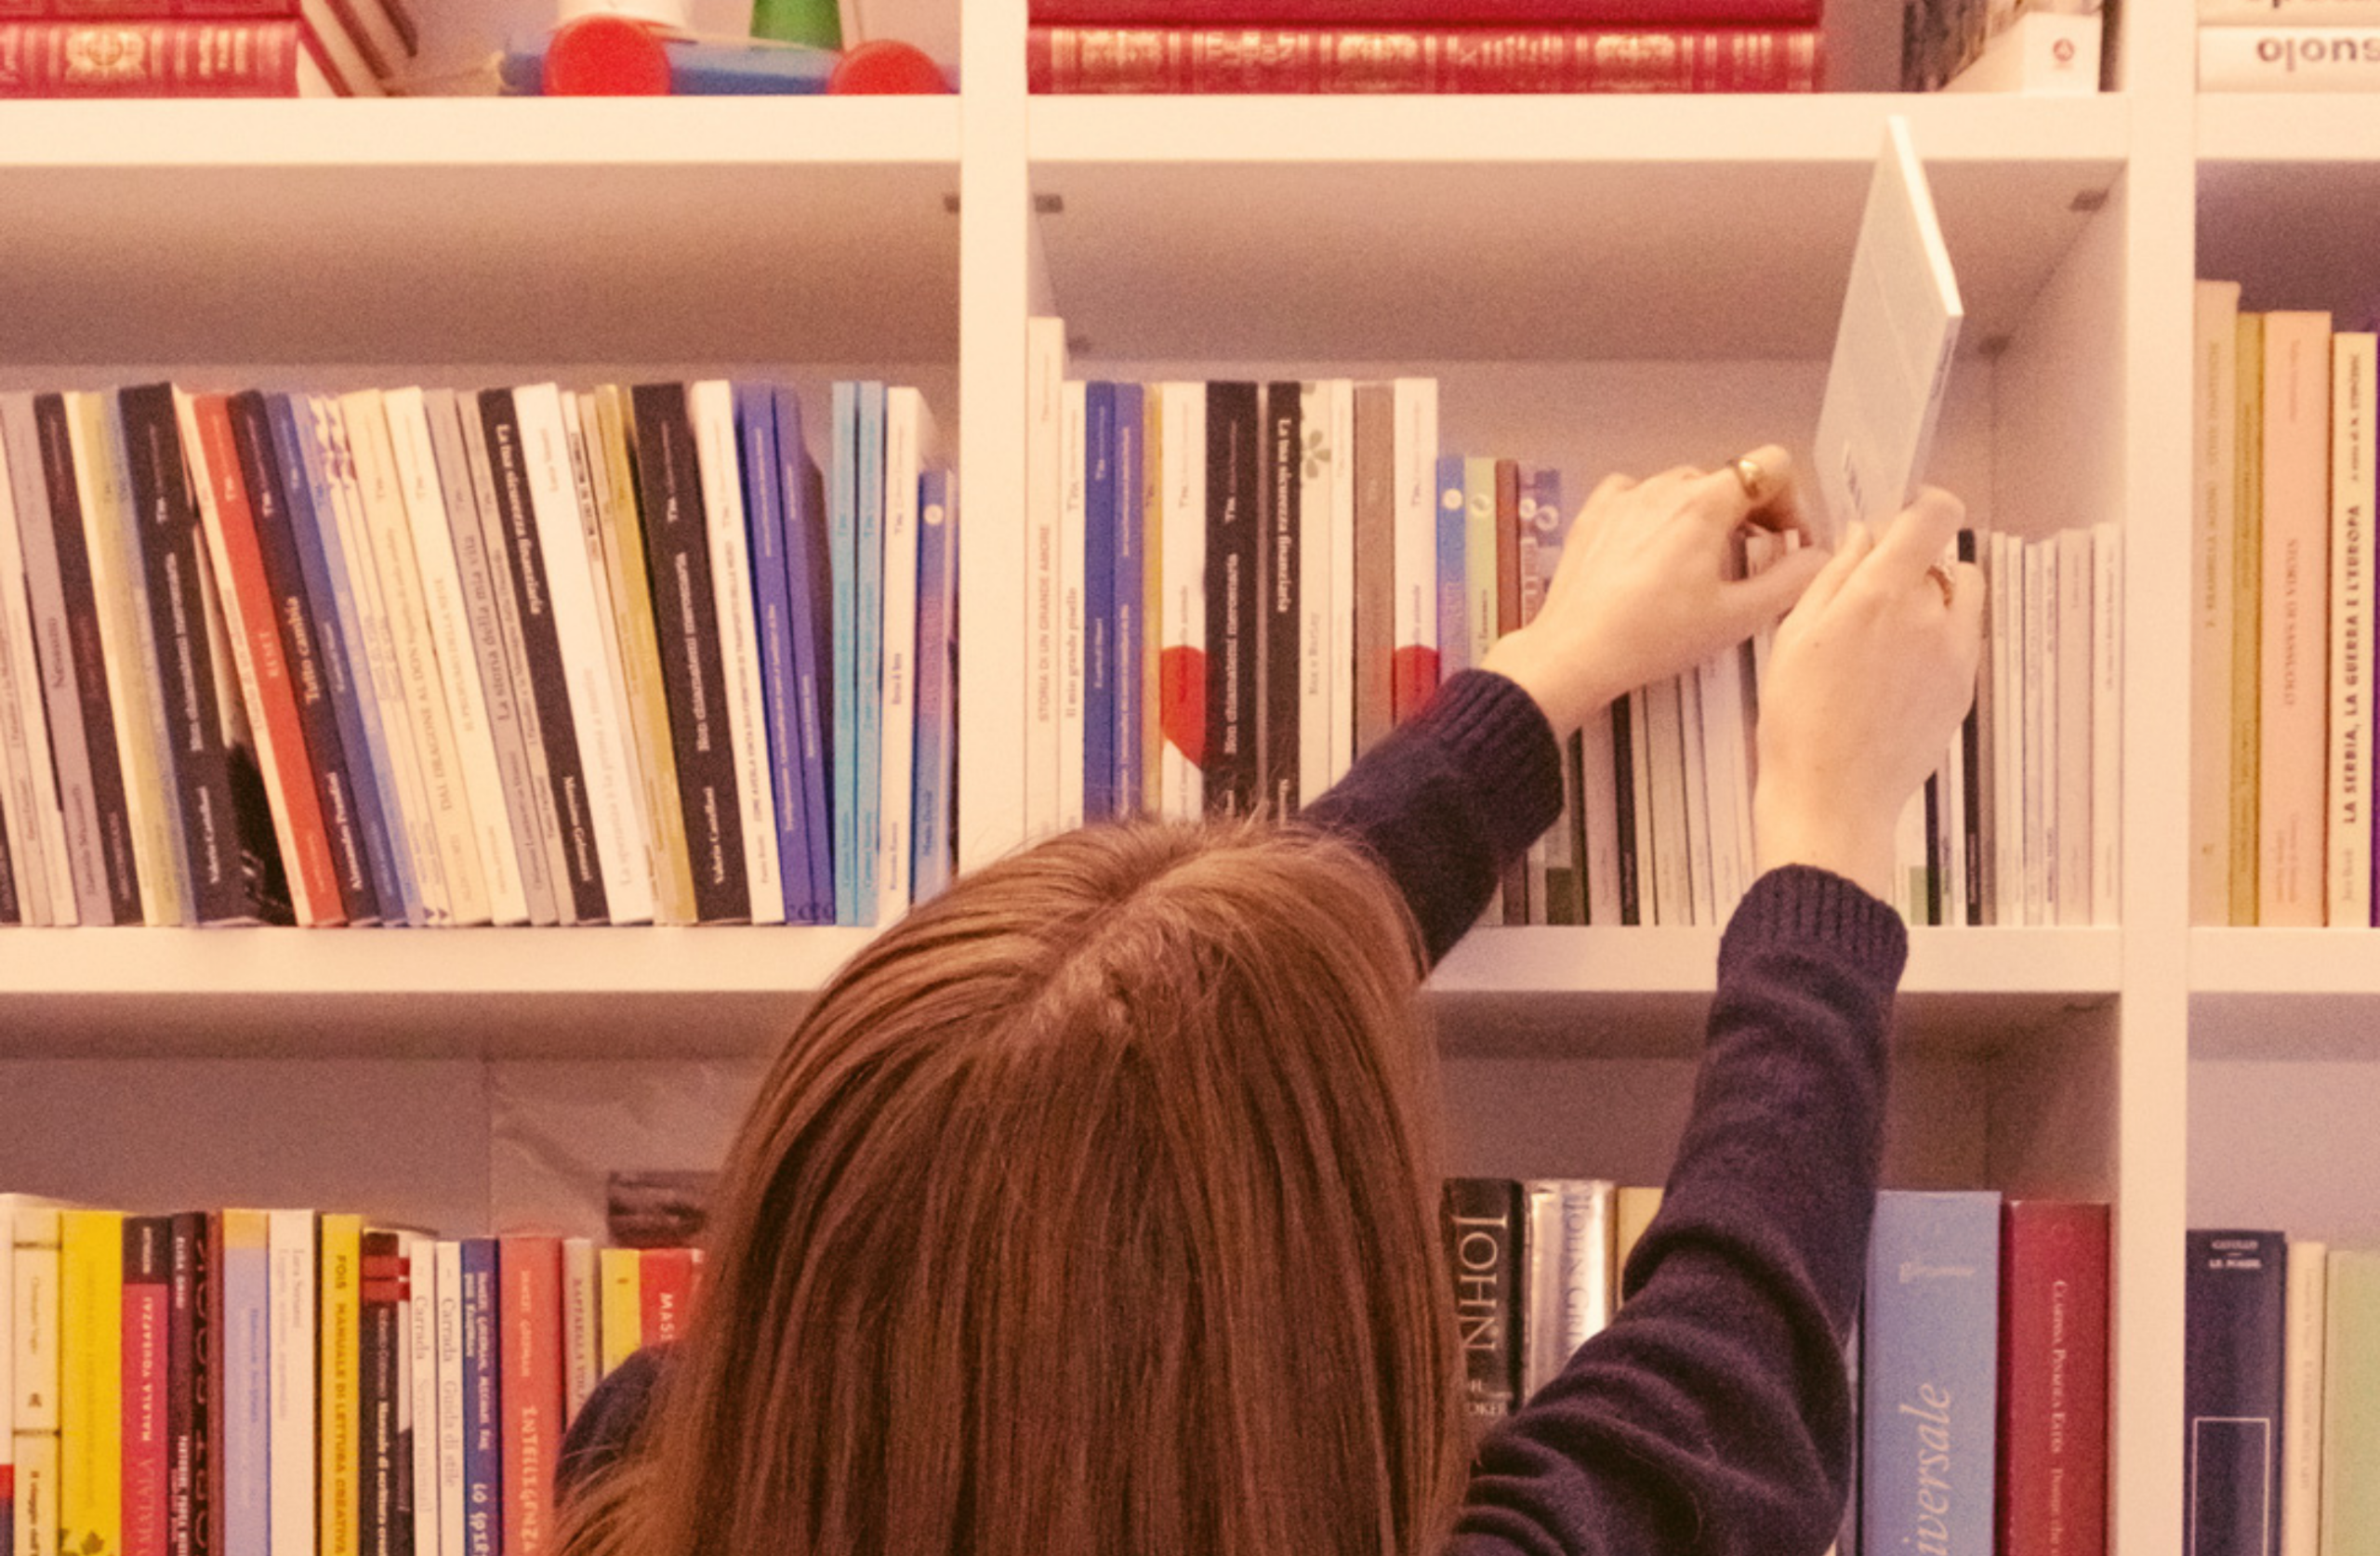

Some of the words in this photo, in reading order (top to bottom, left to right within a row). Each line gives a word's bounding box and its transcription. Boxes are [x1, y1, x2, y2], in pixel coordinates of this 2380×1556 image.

[495, 423, 511, 442] La
[1277, 418, 1290, 435] La
[499, 444, 515, 468] tua
[1278, 440, 1290, 462] tua
[504, 469, 529, 536] sicurezza
[1277, 466, 1291, 531] sicurezza
[460, 534, 479, 566] vita
[1039, 524, 1050, 571] AMORE
[2346, 504, 2360, 590] L'EUROPA
[468, 570, 486, 601] mia
[516, 536, 544, 615] finanziaria
[1276, 534, 1290, 612] finanziaria
[1038, 575, 1049, 629] GRANDE
[2345, 598, 2359, 606] E
[283, 595, 310, 657] cambia
[475, 605, 496, 647] della
[1038, 634, 1049, 653] UN
[2344, 614, 2358, 685] GUERRA
[174, 635, 199, 720] chiamatemi
[483, 650, 506, 697] storia
[684, 634, 707, 719] chiamatemi
[1038, 655, 1049, 669] DI
[1065, 633, 1079, 677] grande
[297, 658, 321, 704] Tutto
[1038, 674, 1049, 721] STORIA
[1224, 639, 1238, 721] chiamatemi
[494, 700, 510, 721] La
[2344, 692, 2358, 716] LA
[187, 723, 204, 751] Non
[419, 705, 445, 779] DRAGONE
[694, 722, 710, 751] Non
[1223, 724, 1237, 753] Non
[2343, 801, 2357, 823] LA
[335, 1255, 346, 1289] FOIS
[520, 1271, 531, 1312] DANIEL
[1451, 1214, 1507, 1352] JOHN
[141, 1297, 152, 1377] YOUSAFZAI
[335, 1302, 346, 1378] MANUALE
[414, 1296, 429, 1360] Carrada
[442, 1298, 456, 1362] Carrada
[520, 1319, 533, 1377] GOLEMAN
[141, 1383, 152, 1441] MALALA
[335, 1382, 346, 1398] DI
[443, 1379, 457, 1427] Guida
[334, 1403, 346, 1473] LETTURA
[377, 1401, 390, 1453] Manuale
[444, 1434, 458, 1448] di
[377, 1456, 389, 1468] di
[445, 1454, 458, 1486] stile
[519, 1404, 538, 1552] INTELLIGENZA
[334, 1478, 345, 1554] CREATIVA
[471, 1483, 485, 1502] LO
